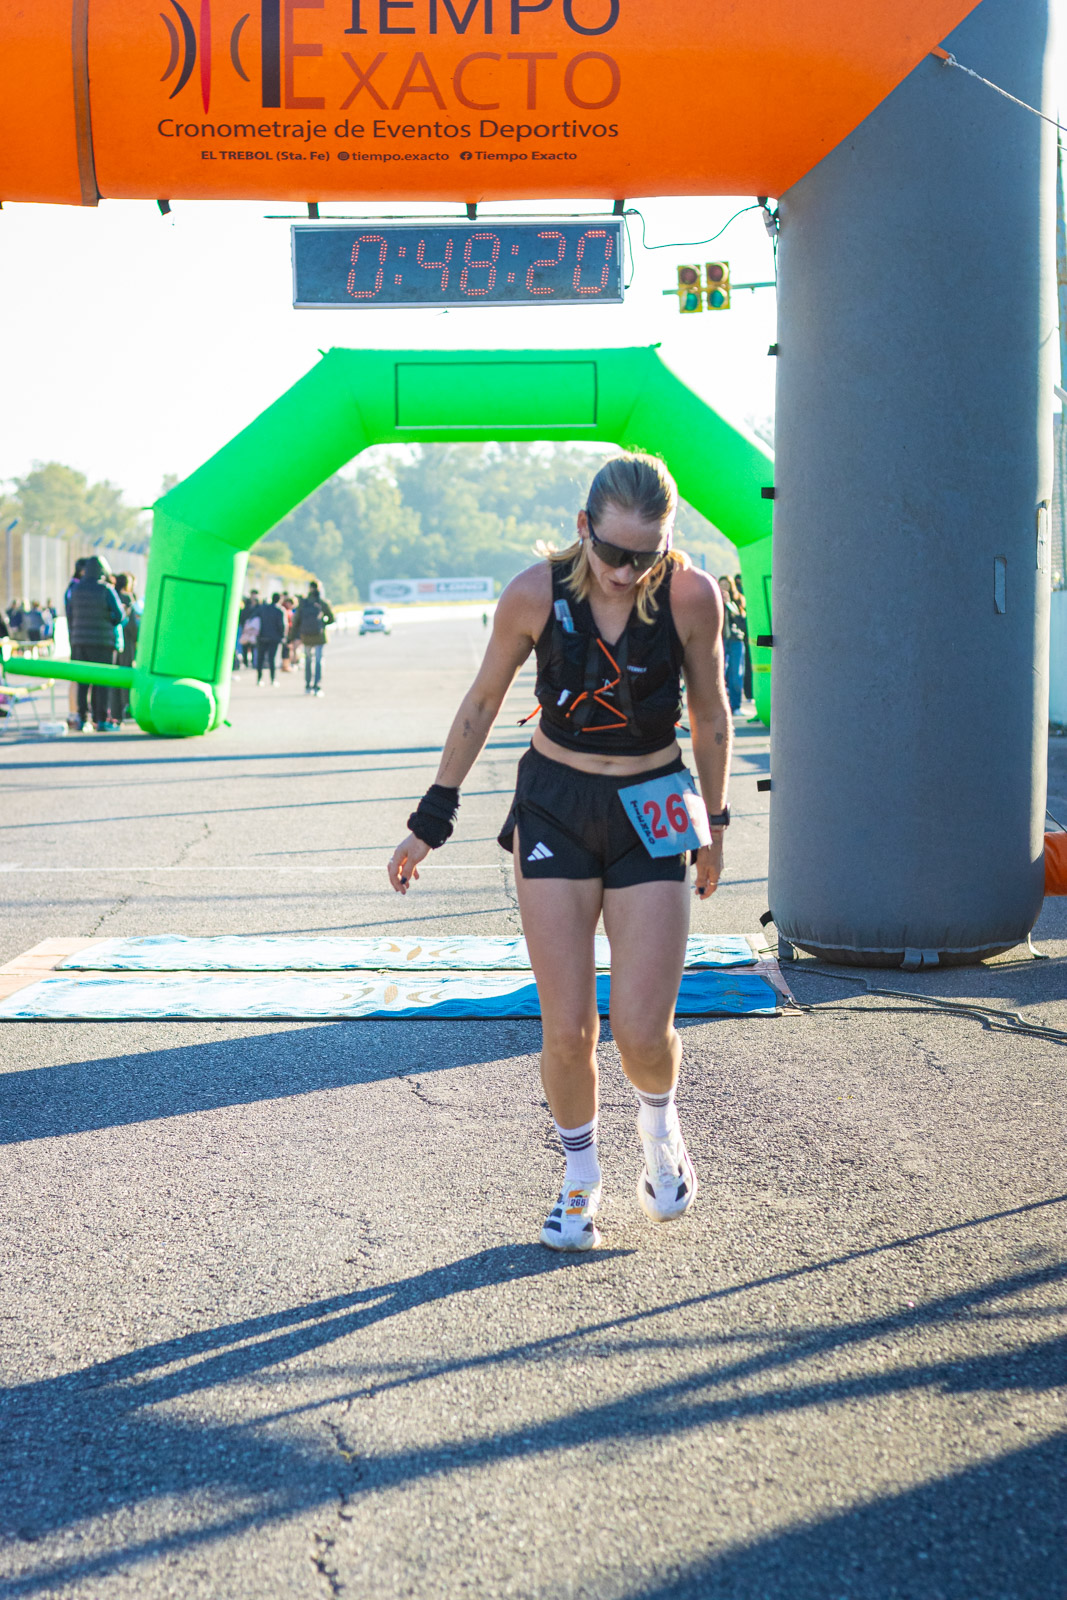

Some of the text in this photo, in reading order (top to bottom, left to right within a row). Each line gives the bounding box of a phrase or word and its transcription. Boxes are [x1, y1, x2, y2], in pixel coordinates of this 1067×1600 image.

[157, 118, 619, 142] Cronometraje de Eventos Deportivos
[201, 151, 578, 162] EL TREBOL (Sta. Fe) tiempo.exacto Tiempo Exacto
[347, 231, 614, 298] 0:48:20
